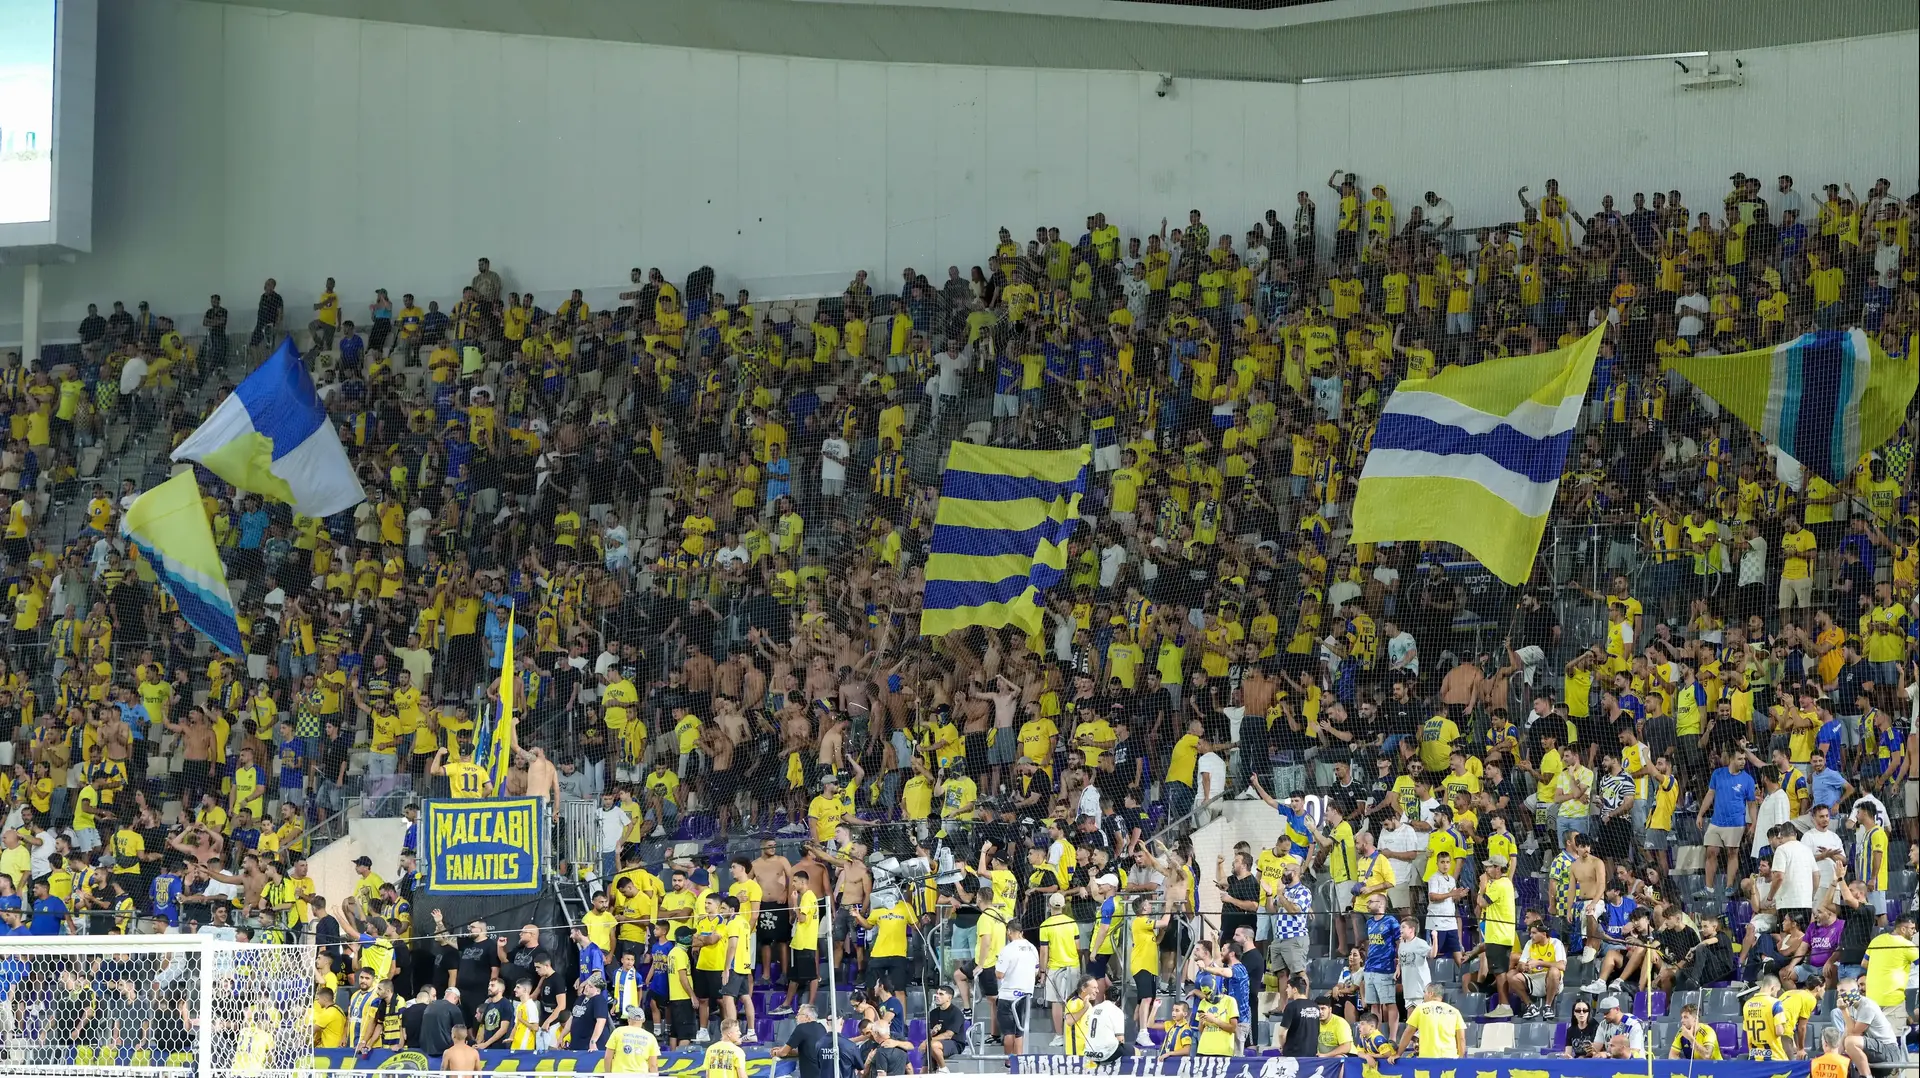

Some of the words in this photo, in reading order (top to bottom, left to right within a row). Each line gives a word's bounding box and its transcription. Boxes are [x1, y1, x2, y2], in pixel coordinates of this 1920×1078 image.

[1360, 635, 1374, 652] 42
[461, 773, 478, 792] 11
[436, 810, 530, 857] MACCABI
[446, 853, 519, 880] FANATICS
[1090, 1017, 1098, 1038] 8
[1746, 1020, 1767, 1043] 42
[1130, 1056, 1165, 1077] TEL
[1177, 1056, 1231, 1078] AVIV
